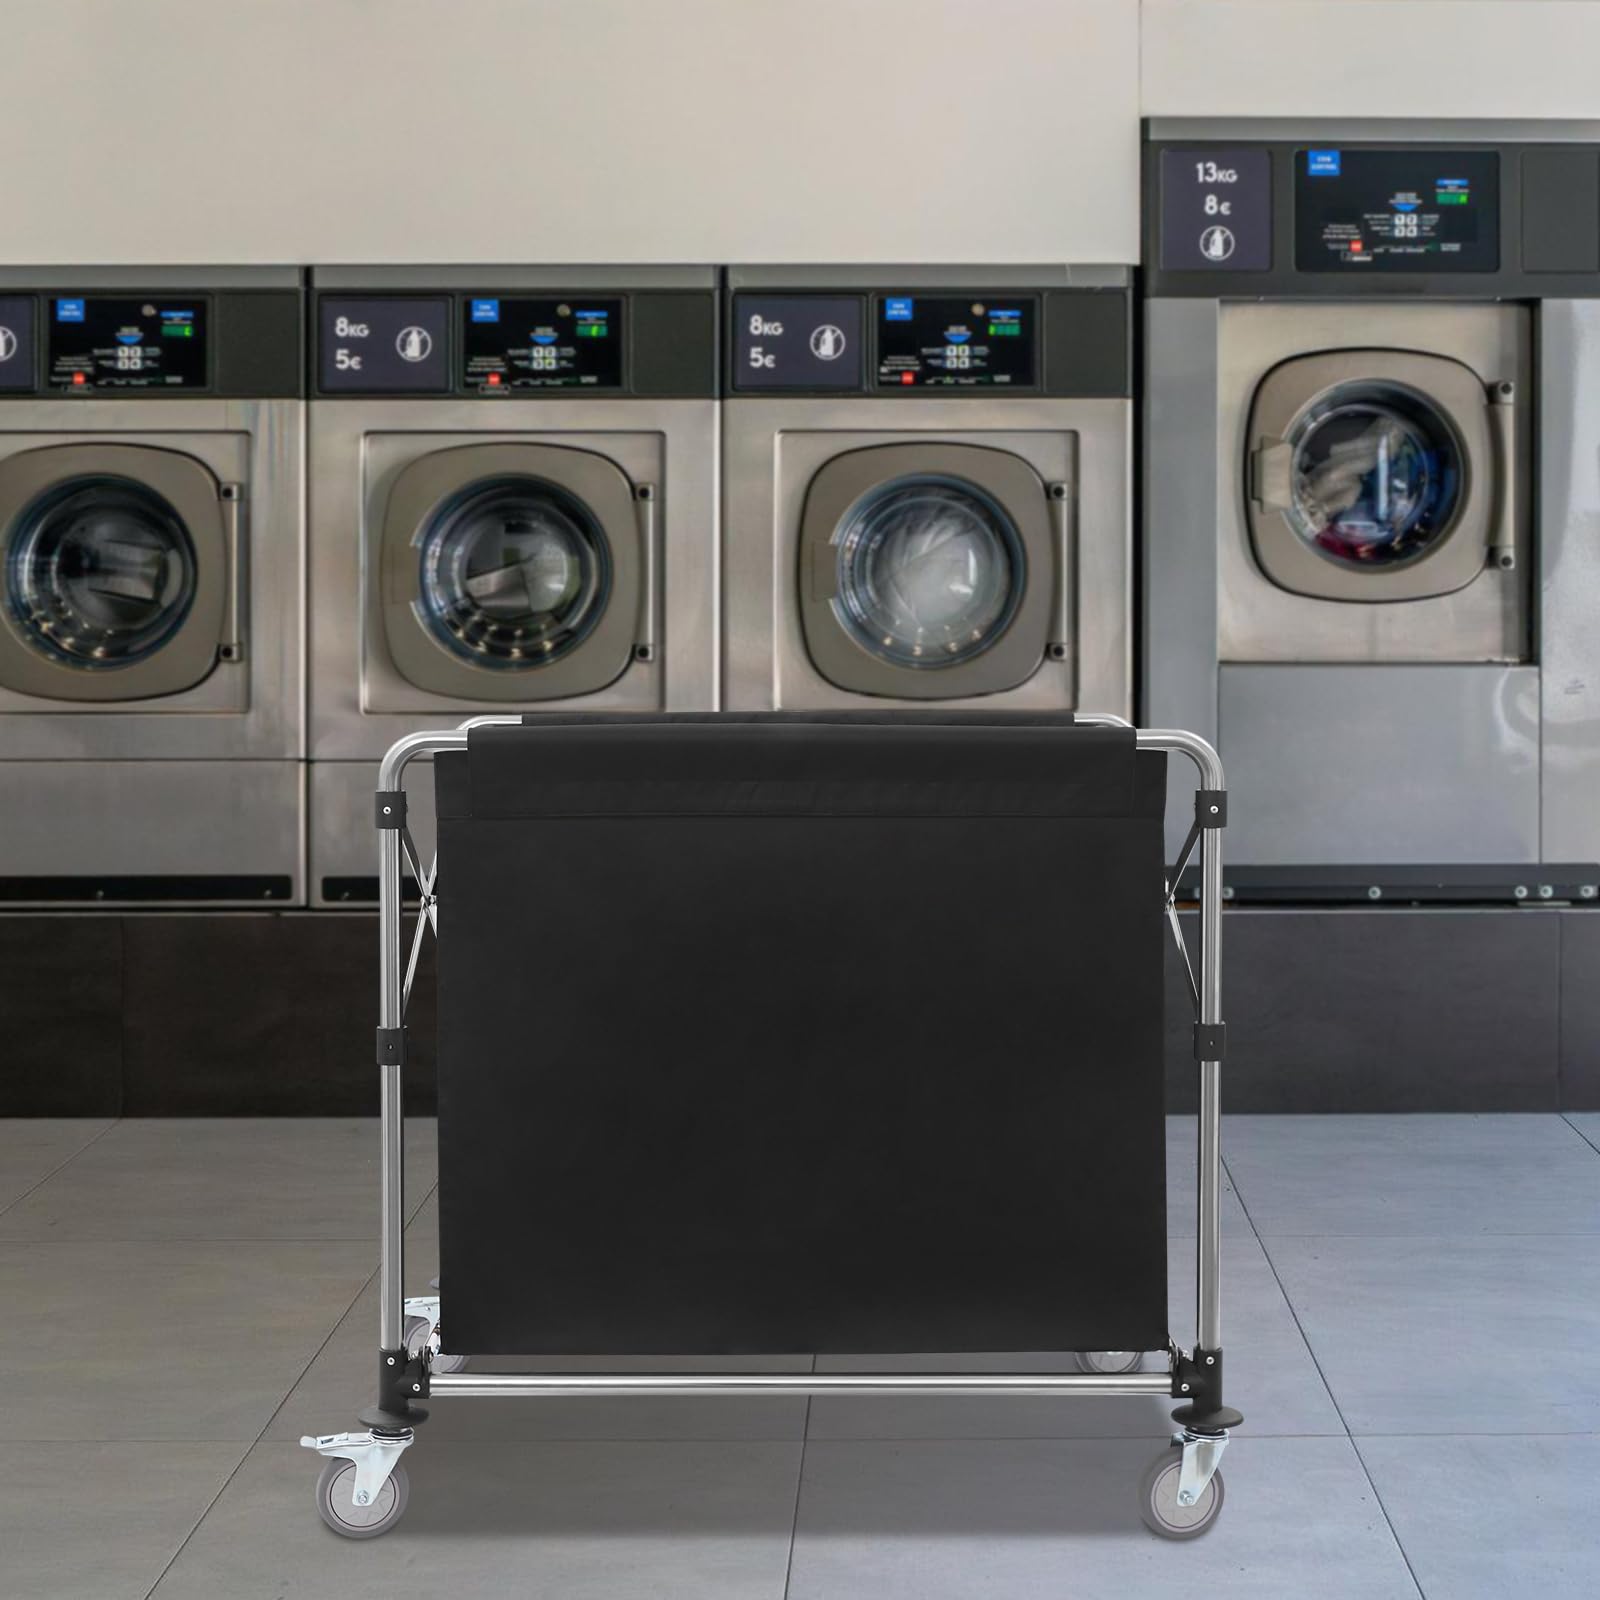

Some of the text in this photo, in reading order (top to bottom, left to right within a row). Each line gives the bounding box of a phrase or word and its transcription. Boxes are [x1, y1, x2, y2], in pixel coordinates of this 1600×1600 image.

[1196, 161, 1238, 183] 13KG
[335, 316, 370, 338] 8KG
[749, 314, 784, 336] 8KG
[335, 348, 362, 370] 5€
[749, 346, 776, 368] 5€
